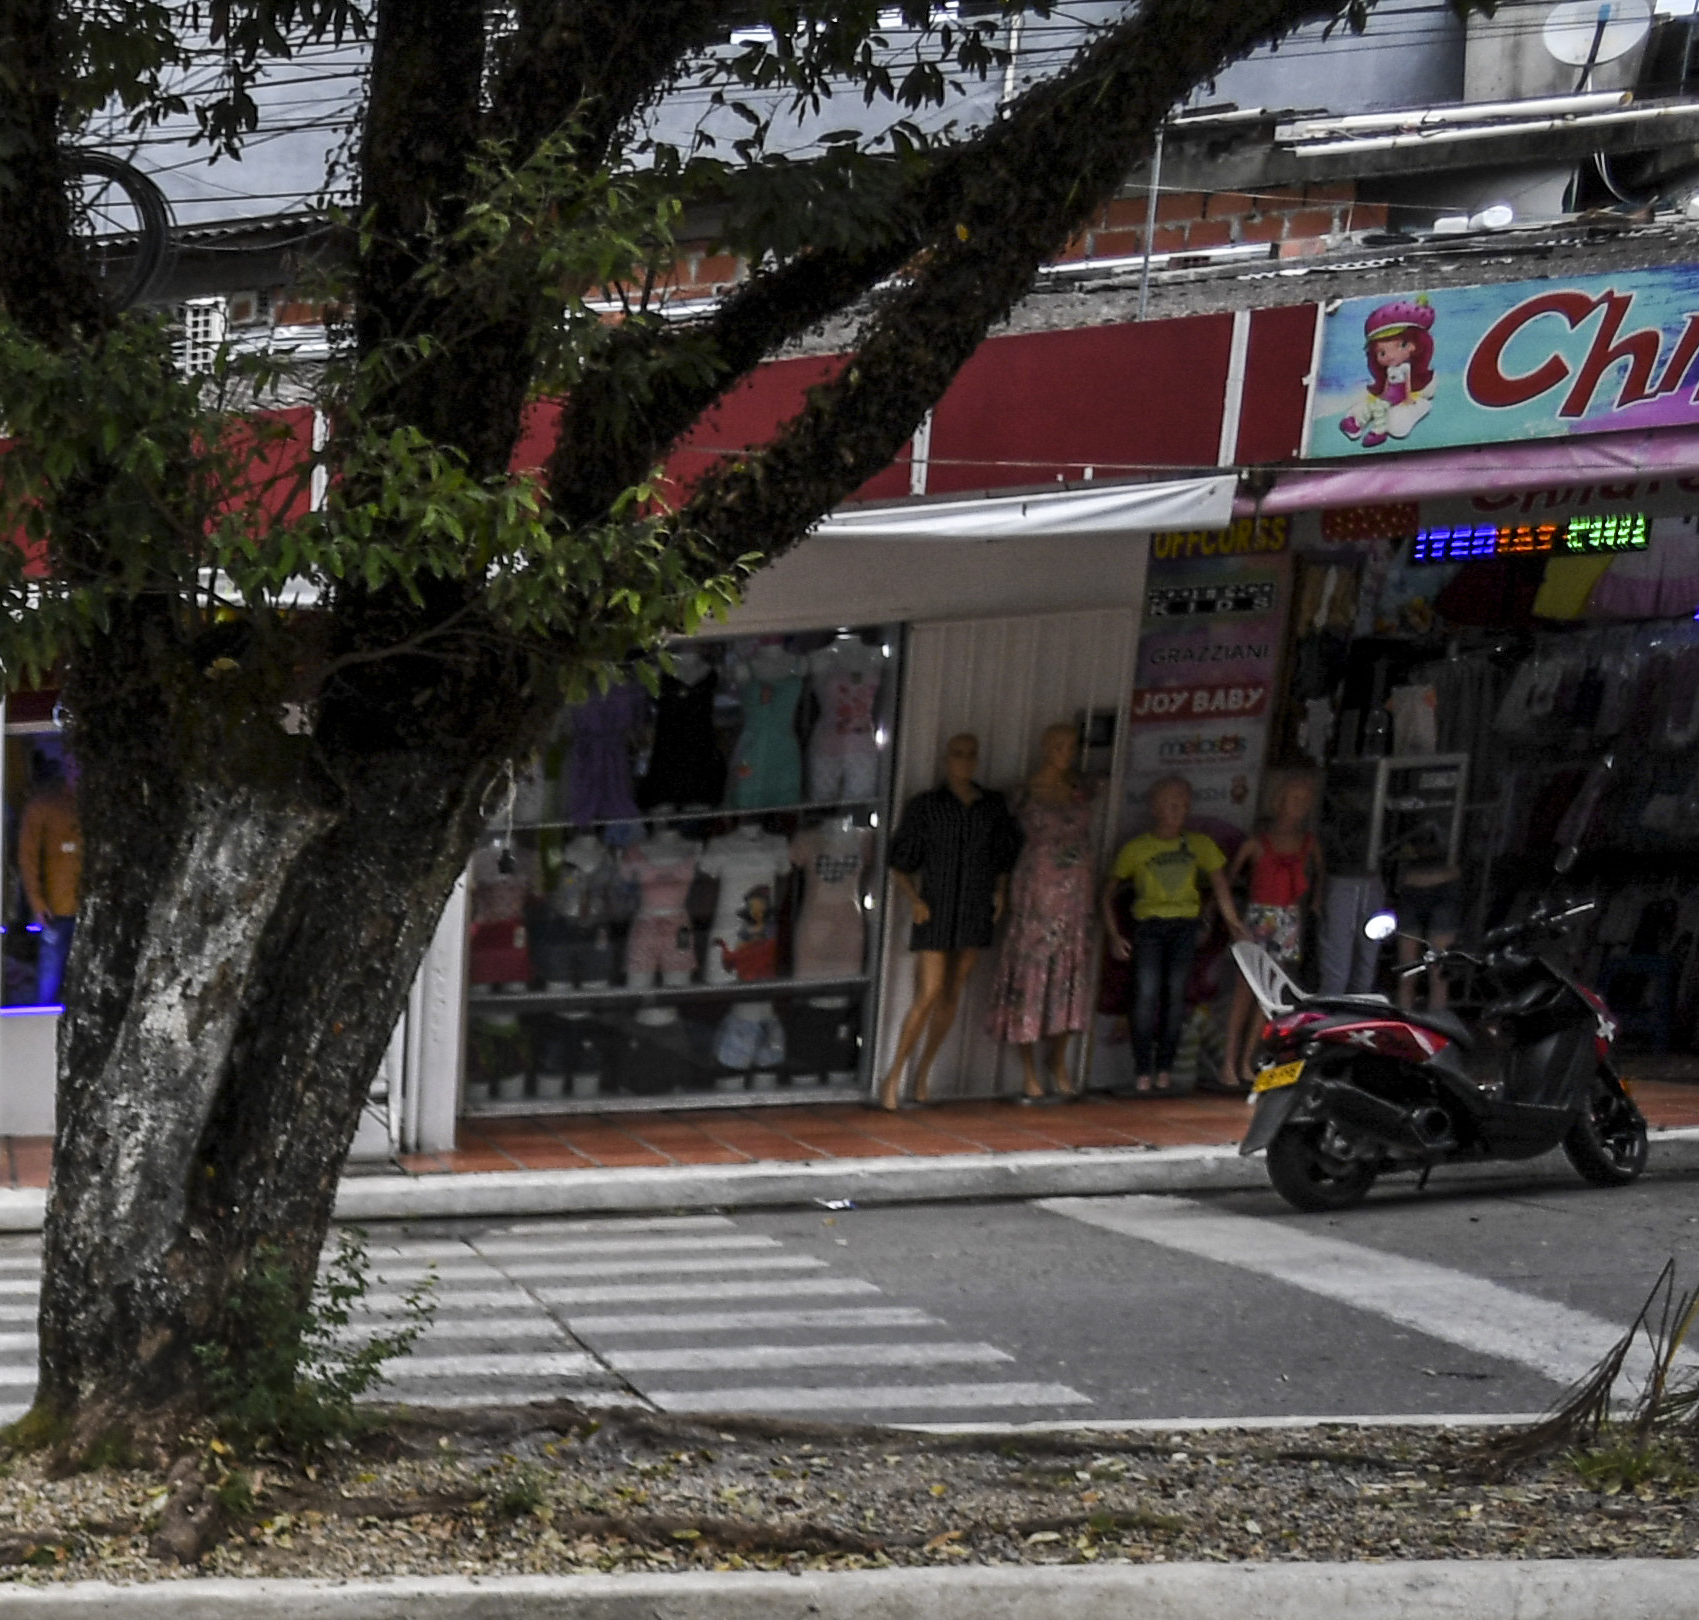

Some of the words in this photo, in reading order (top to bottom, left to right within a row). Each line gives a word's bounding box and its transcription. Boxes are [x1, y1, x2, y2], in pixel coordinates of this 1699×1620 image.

[1466, 288, 1699, 419] Chi
[1151, 644, 1269, 664] GRAZZIANI
[1135, 689, 1189, 716] JOY
[1191, 688, 1264, 713] BABY
